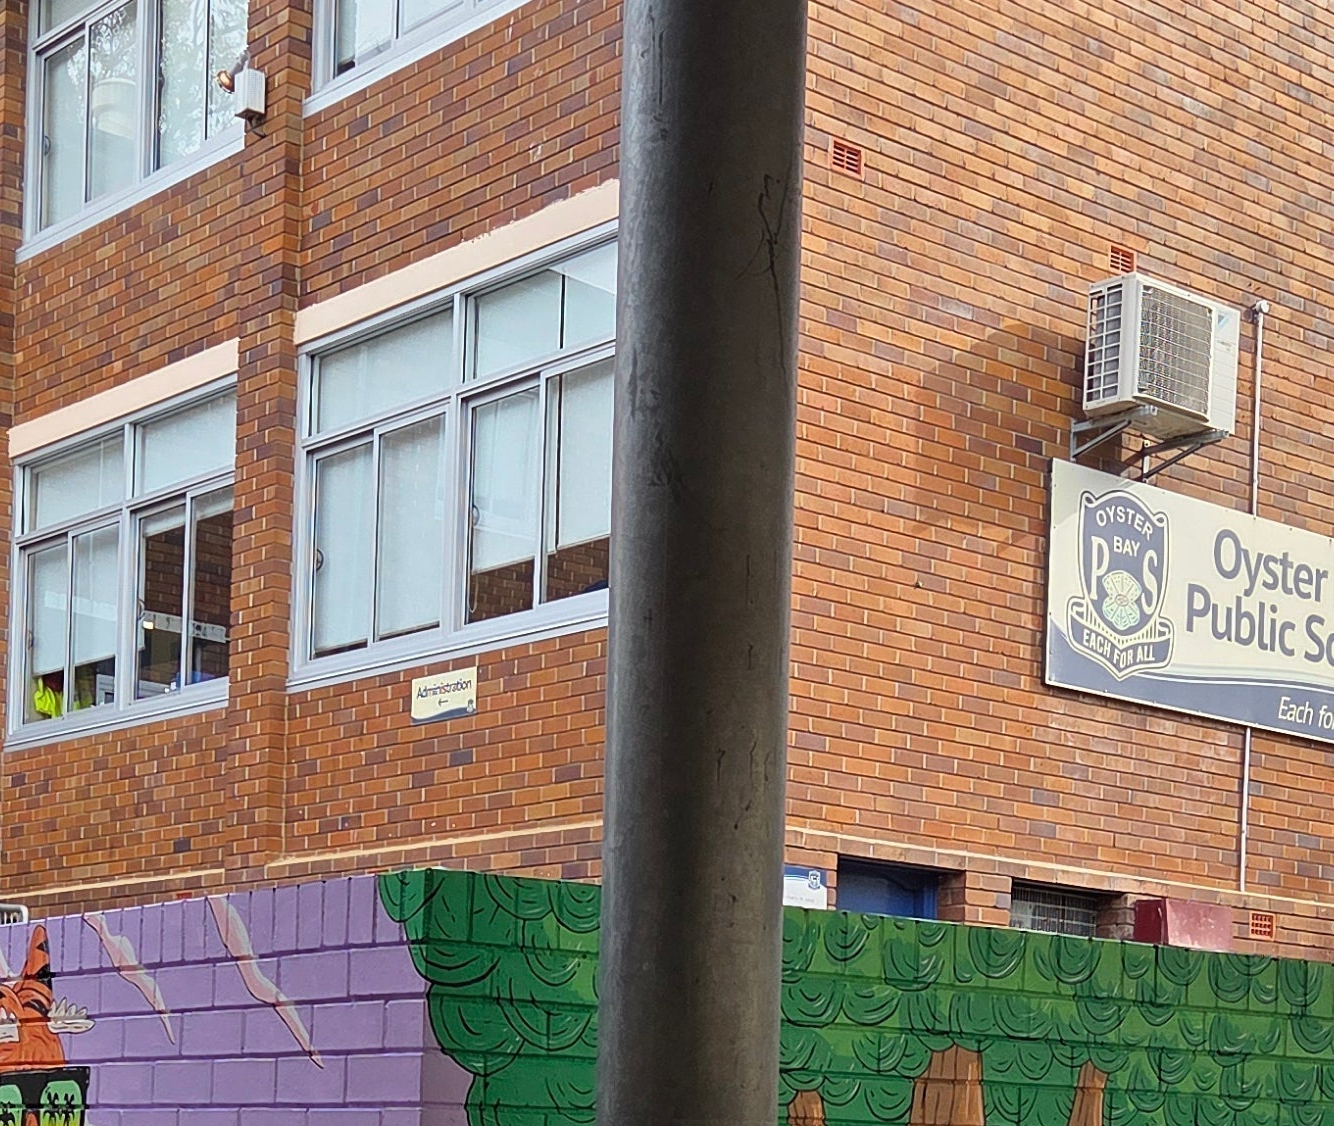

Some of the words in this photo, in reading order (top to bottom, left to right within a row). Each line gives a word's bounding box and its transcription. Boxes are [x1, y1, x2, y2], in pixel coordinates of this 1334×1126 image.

[1096, 505, 1153, 541] OYSTER
[1113, 536, 1140, 557] BAY
[1213, 529, 1329, 602] Oyster
[1090, 535, 1110, 600] P
[1141, 549, 1158, 615] S
[1186, 583, 1296, 657] Public
[1083, 628, 1112, 660] EACH
[1113, 649, 1134, 669] FOR
[1136, 645, 1155, 664] ALL
[417, 678, 472, 699] Administration
[1278, 696, 1314, 726] Each
